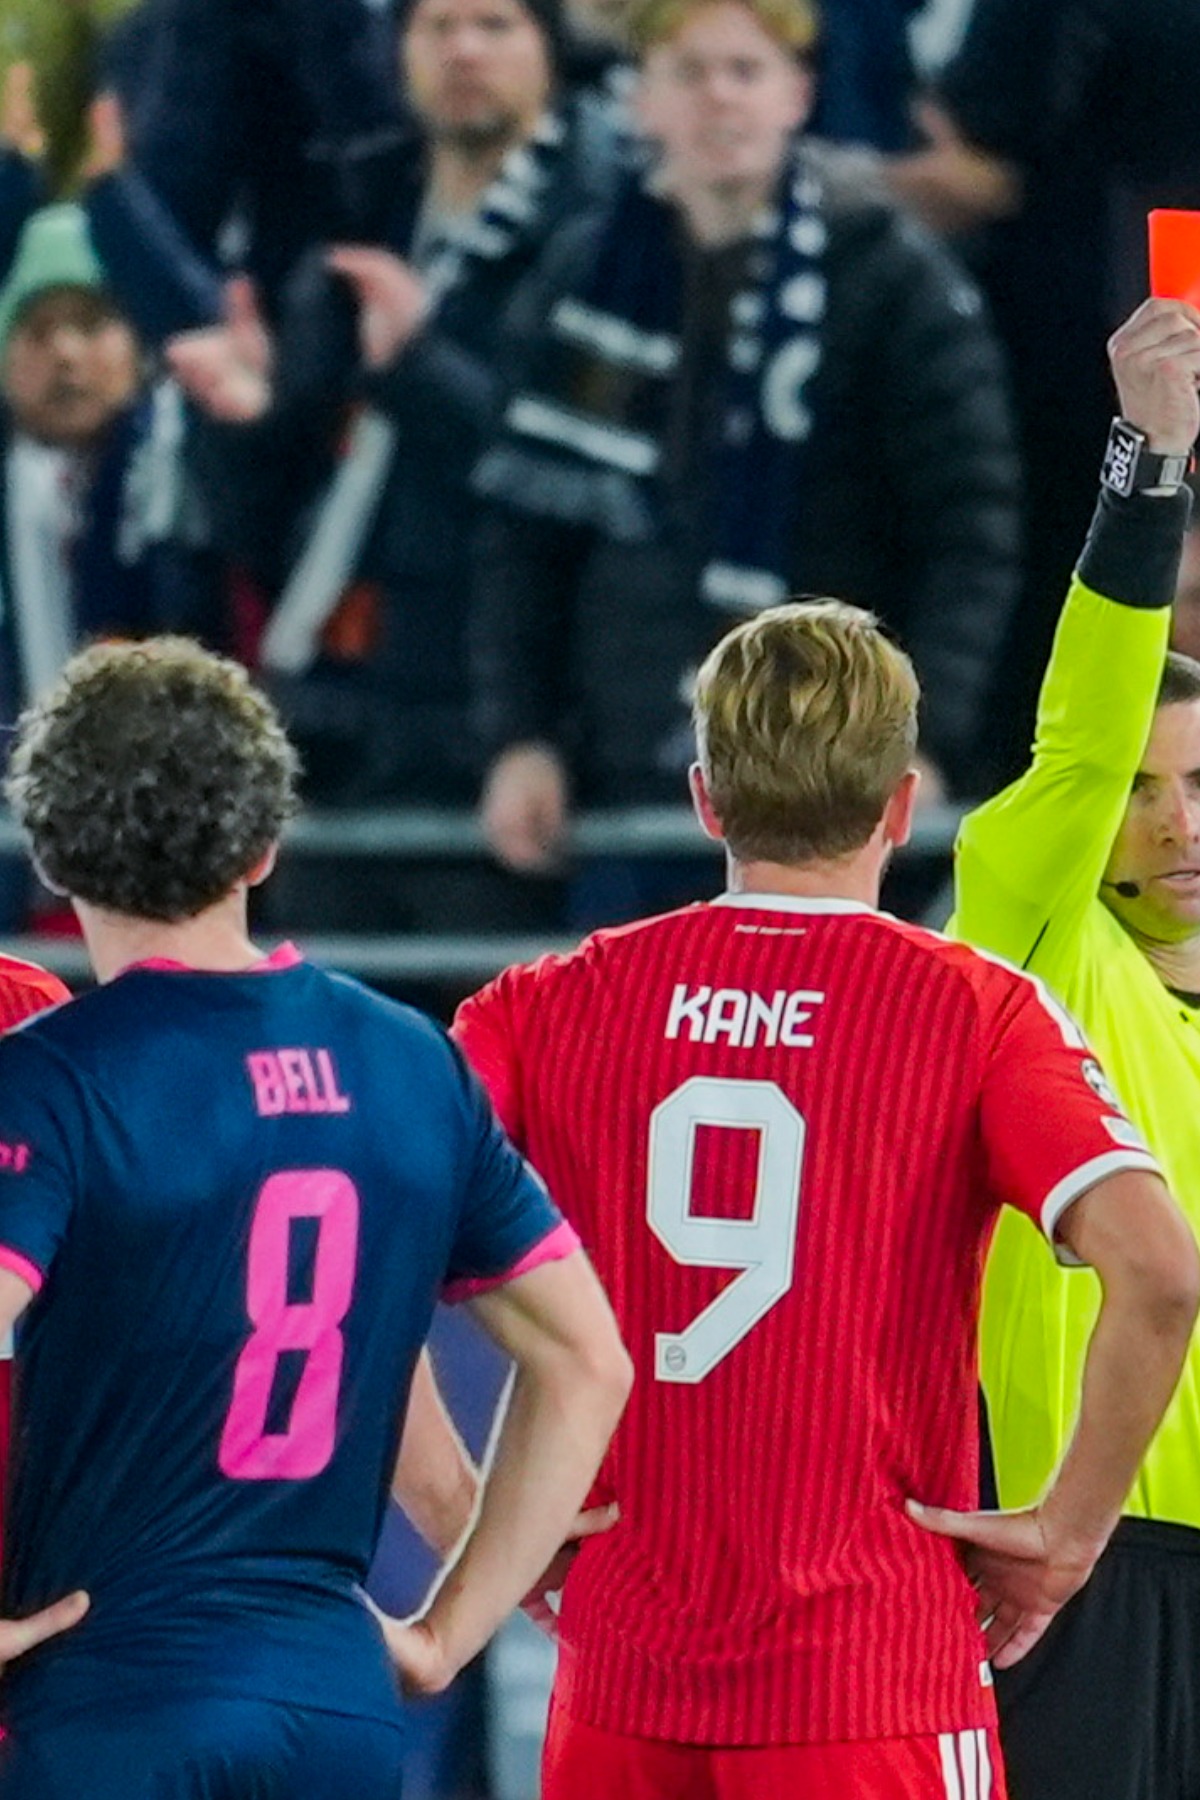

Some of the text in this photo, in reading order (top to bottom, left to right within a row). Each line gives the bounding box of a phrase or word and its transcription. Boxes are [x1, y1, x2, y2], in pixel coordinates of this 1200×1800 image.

[247, 1048, 351, 1117] BELL
[664, 983, 826, 1048] KANE
[218, 1168, 360, 1480] 8
[646, 1075, 806, 1384] 9
